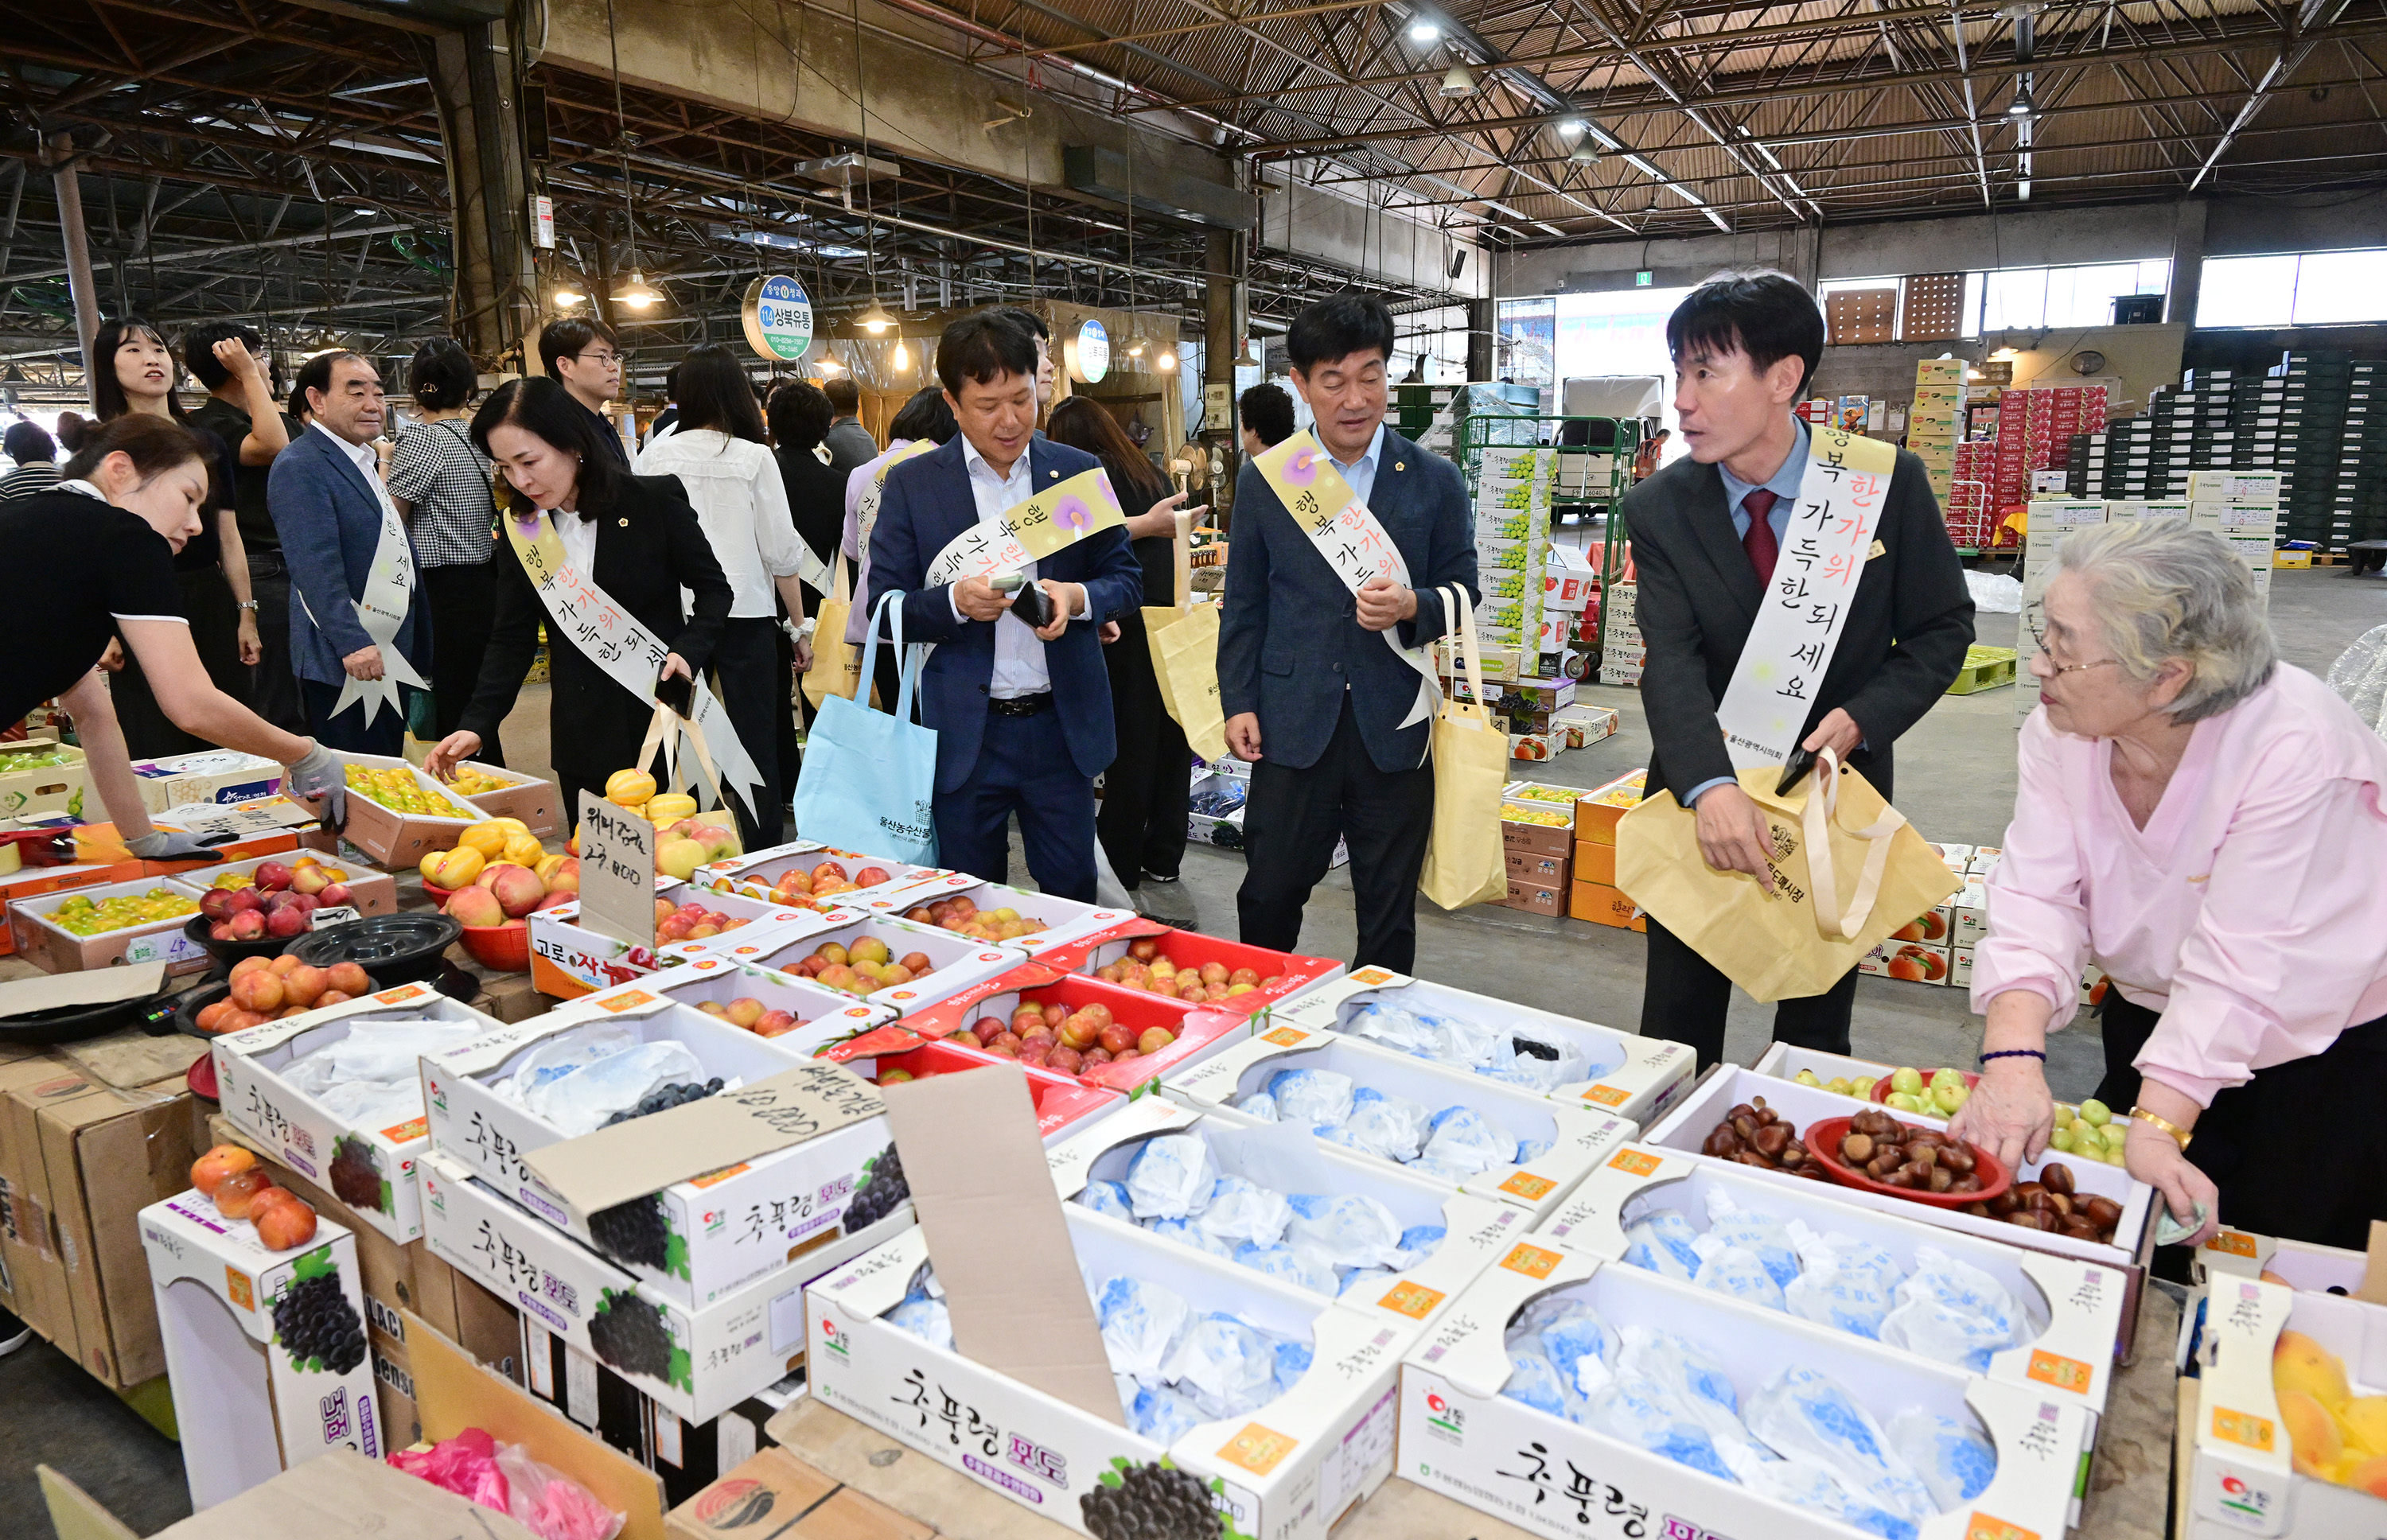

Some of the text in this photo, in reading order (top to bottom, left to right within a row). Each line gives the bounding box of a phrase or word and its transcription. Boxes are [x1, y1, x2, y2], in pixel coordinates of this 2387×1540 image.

[761, 309, 810, 329] 114 상북유통
[999, 504, 1048, 538] 행복
[1295, 491, 1336, 537] 행복
[1340, 507, 1400, 578] 한가위
[1780, 426, 1851, 611] 행복 가득한
[957, 542, 1025, 582] 한가
[1775, 475, 1881, 702] 한가위 되세요
[526, 545, 621, 662] 행복 가득한
[558, 565, 668, 668] 한가위 되세
[698, 695, 712, 725] 산광역시의회
[1730, 734, 1783, 760] 울산광역시의회
[879, 816, 931, 839] 울산농수산물
[536, 939, 566, 963] 고로
[247, 1084, 290, 1142] 추풍령
[465, 1111, 528, 1182] 추풍령
[734, 1176, 854, 1245] 추풍령 포도
[473, 1219, 538, 1292] 추풍령
[542, 1270, 580, 1317] 포도
[320, 1386, 351, 1445] 포도
[890, 1369, 999, 1459] 추풍령
[1007, 1432, 1069, 1490] 포도
[1496, 1442, 1649, 1538] 추풍령
